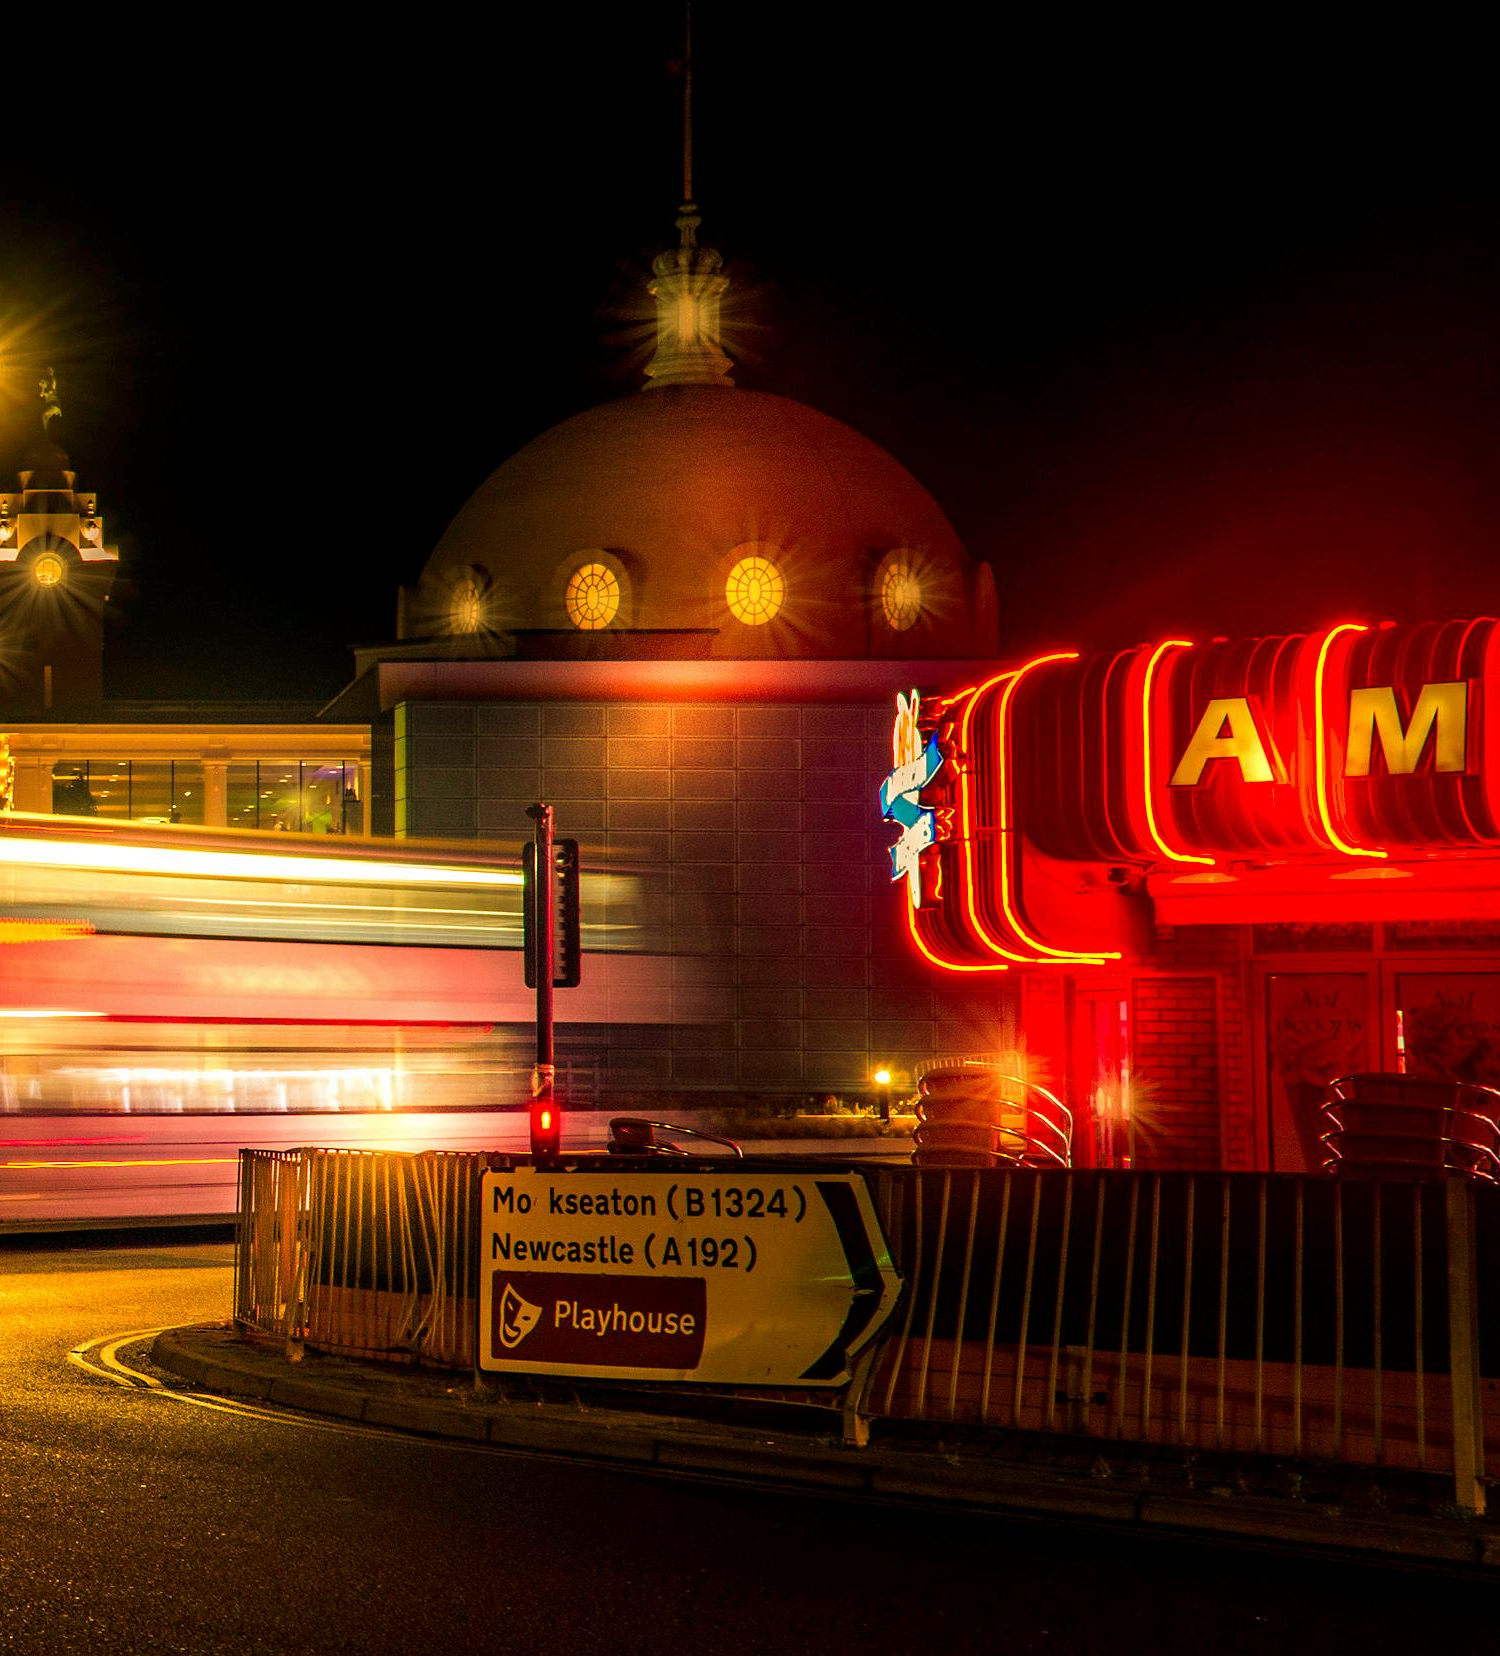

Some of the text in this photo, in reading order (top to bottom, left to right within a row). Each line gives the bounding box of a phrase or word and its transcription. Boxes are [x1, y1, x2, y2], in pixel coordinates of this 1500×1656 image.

[493, 1184, 807, 1223] Mokseaton (B1324)
[492, 1232, 757, 1273] Newcastle (A192)
[554, 1300, 696, 1336] Playhouse
